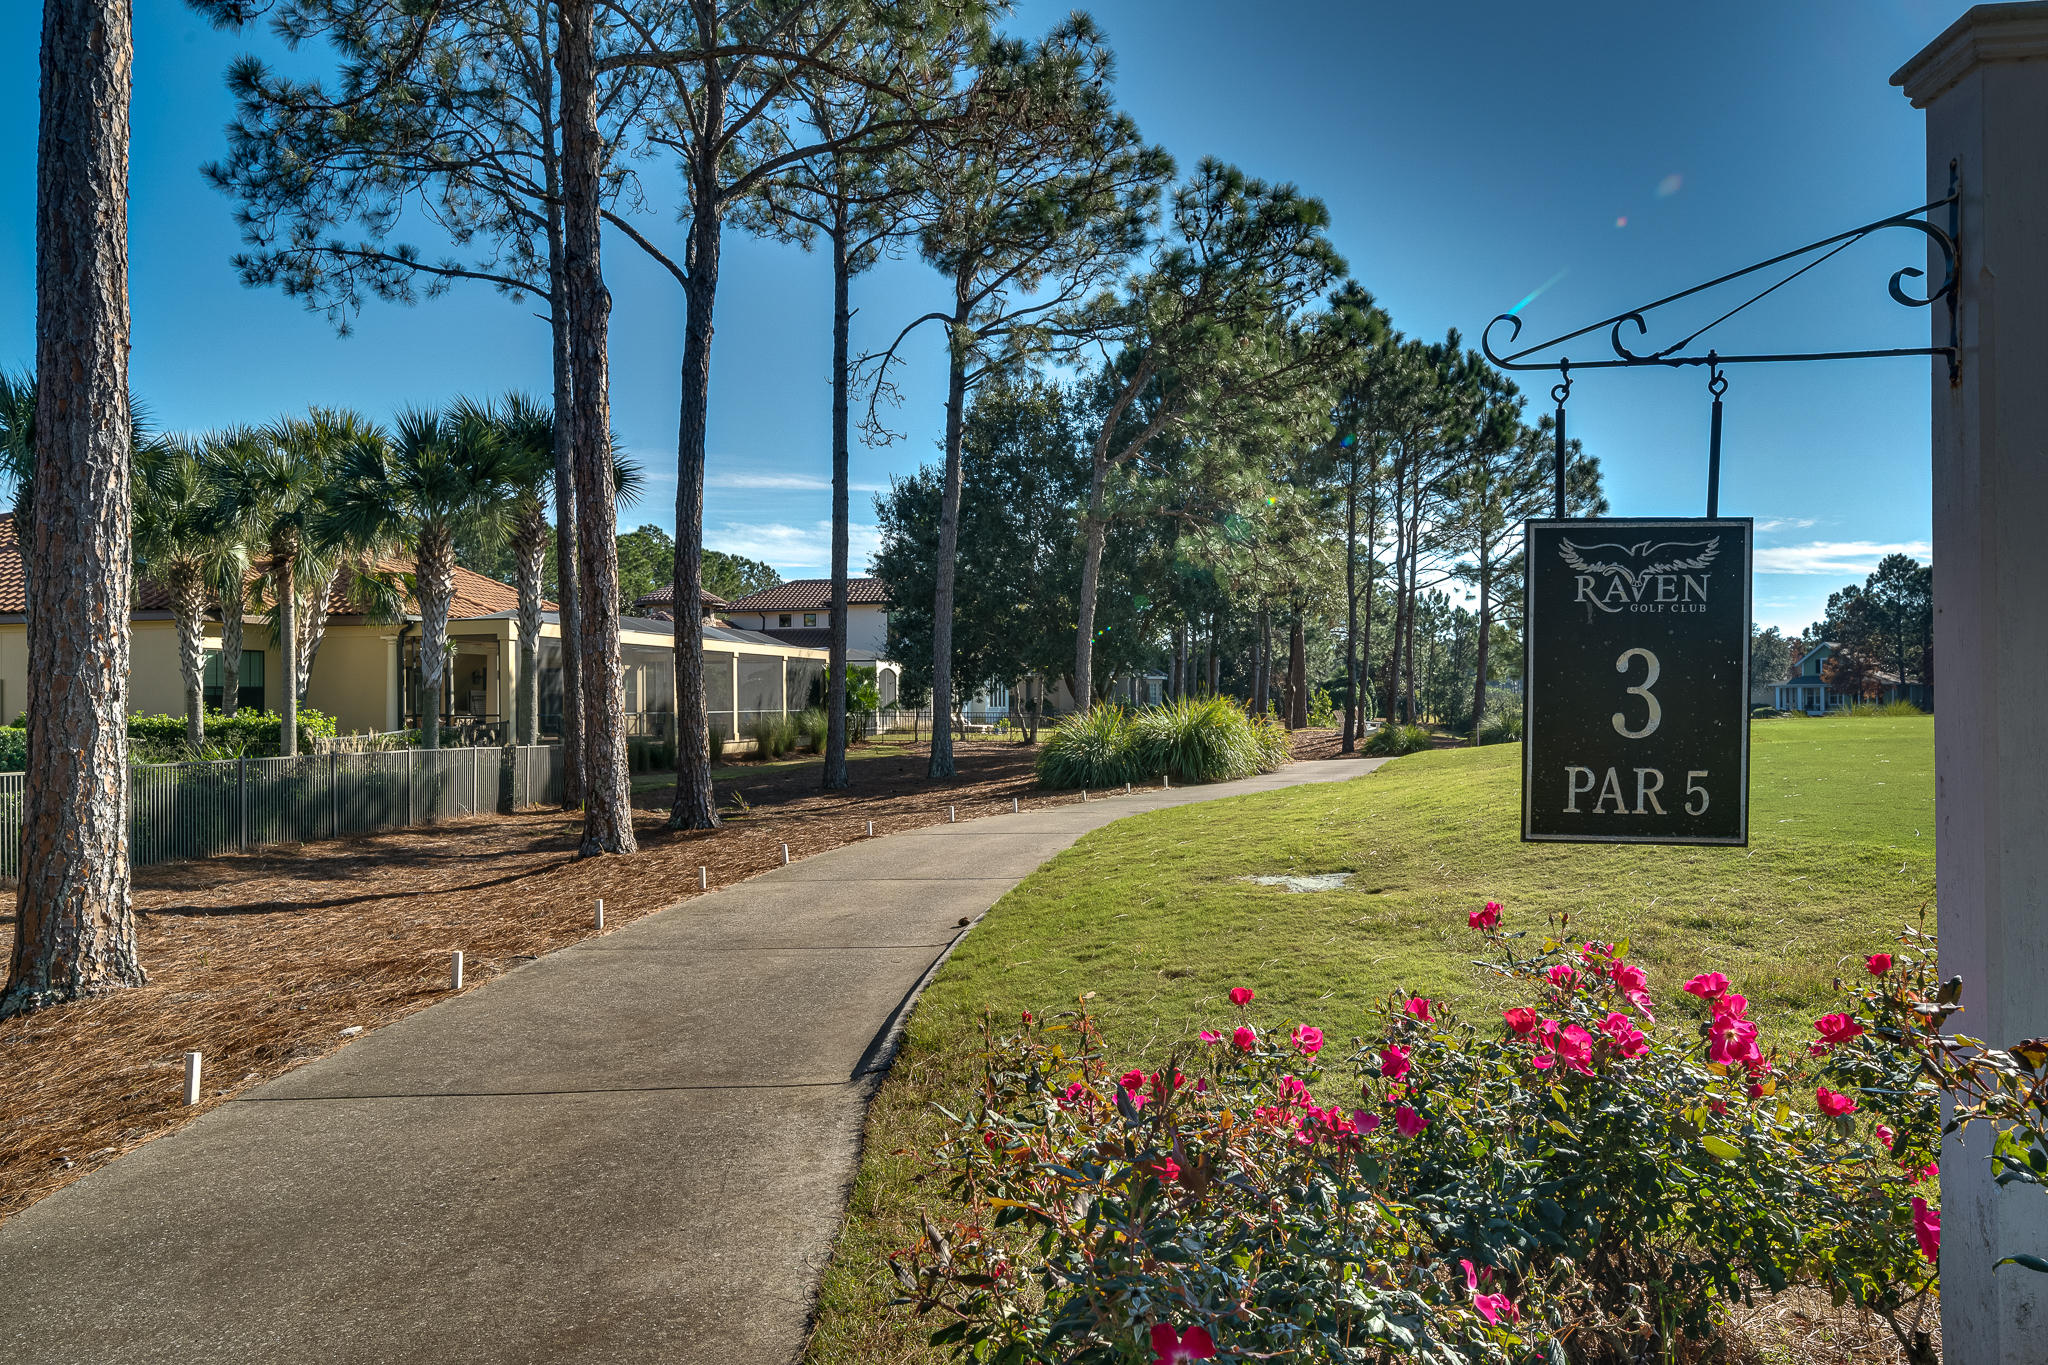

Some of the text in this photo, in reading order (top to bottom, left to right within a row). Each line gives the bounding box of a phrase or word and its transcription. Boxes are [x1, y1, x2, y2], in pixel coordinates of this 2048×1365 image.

[1573, 574, 1711, 613] RAVEN
[1630, 603, 1707, 613] GOLF CLUB
[1611, 647, 1662, 739] 3
[1562, 766, 1710, 816] PAR 5
